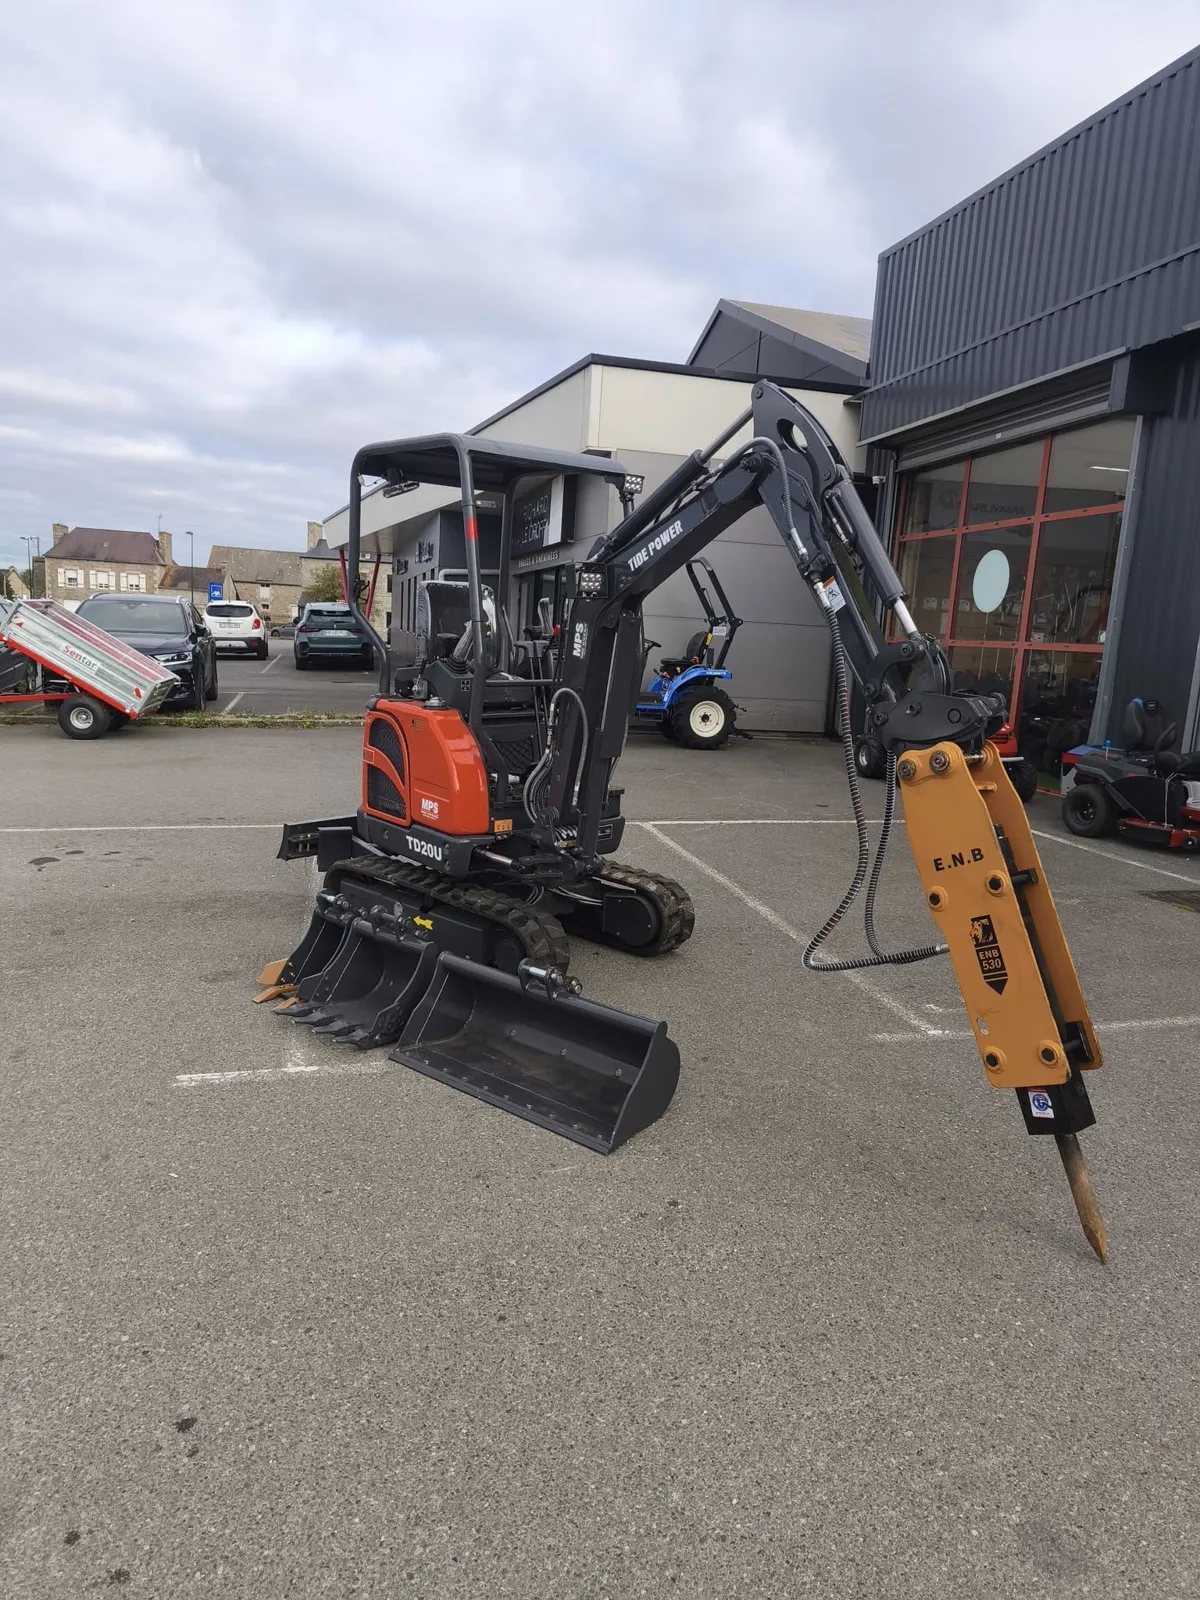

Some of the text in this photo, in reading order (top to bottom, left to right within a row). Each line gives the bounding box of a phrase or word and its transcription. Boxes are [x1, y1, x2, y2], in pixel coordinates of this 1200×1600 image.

[627, 519, 684, 572] TIDE POWER
[572, 622, 584, 658] MPS
[63, 645, 98, 669] Sentar
[421, 797, 439, 814] MPS
[405, 834, 443, 862] TD20U
[933, 847, 985, 872] E.N.B
[978, 949, 1000, 961] ENB
[982, 958, 1002, 971] 530
